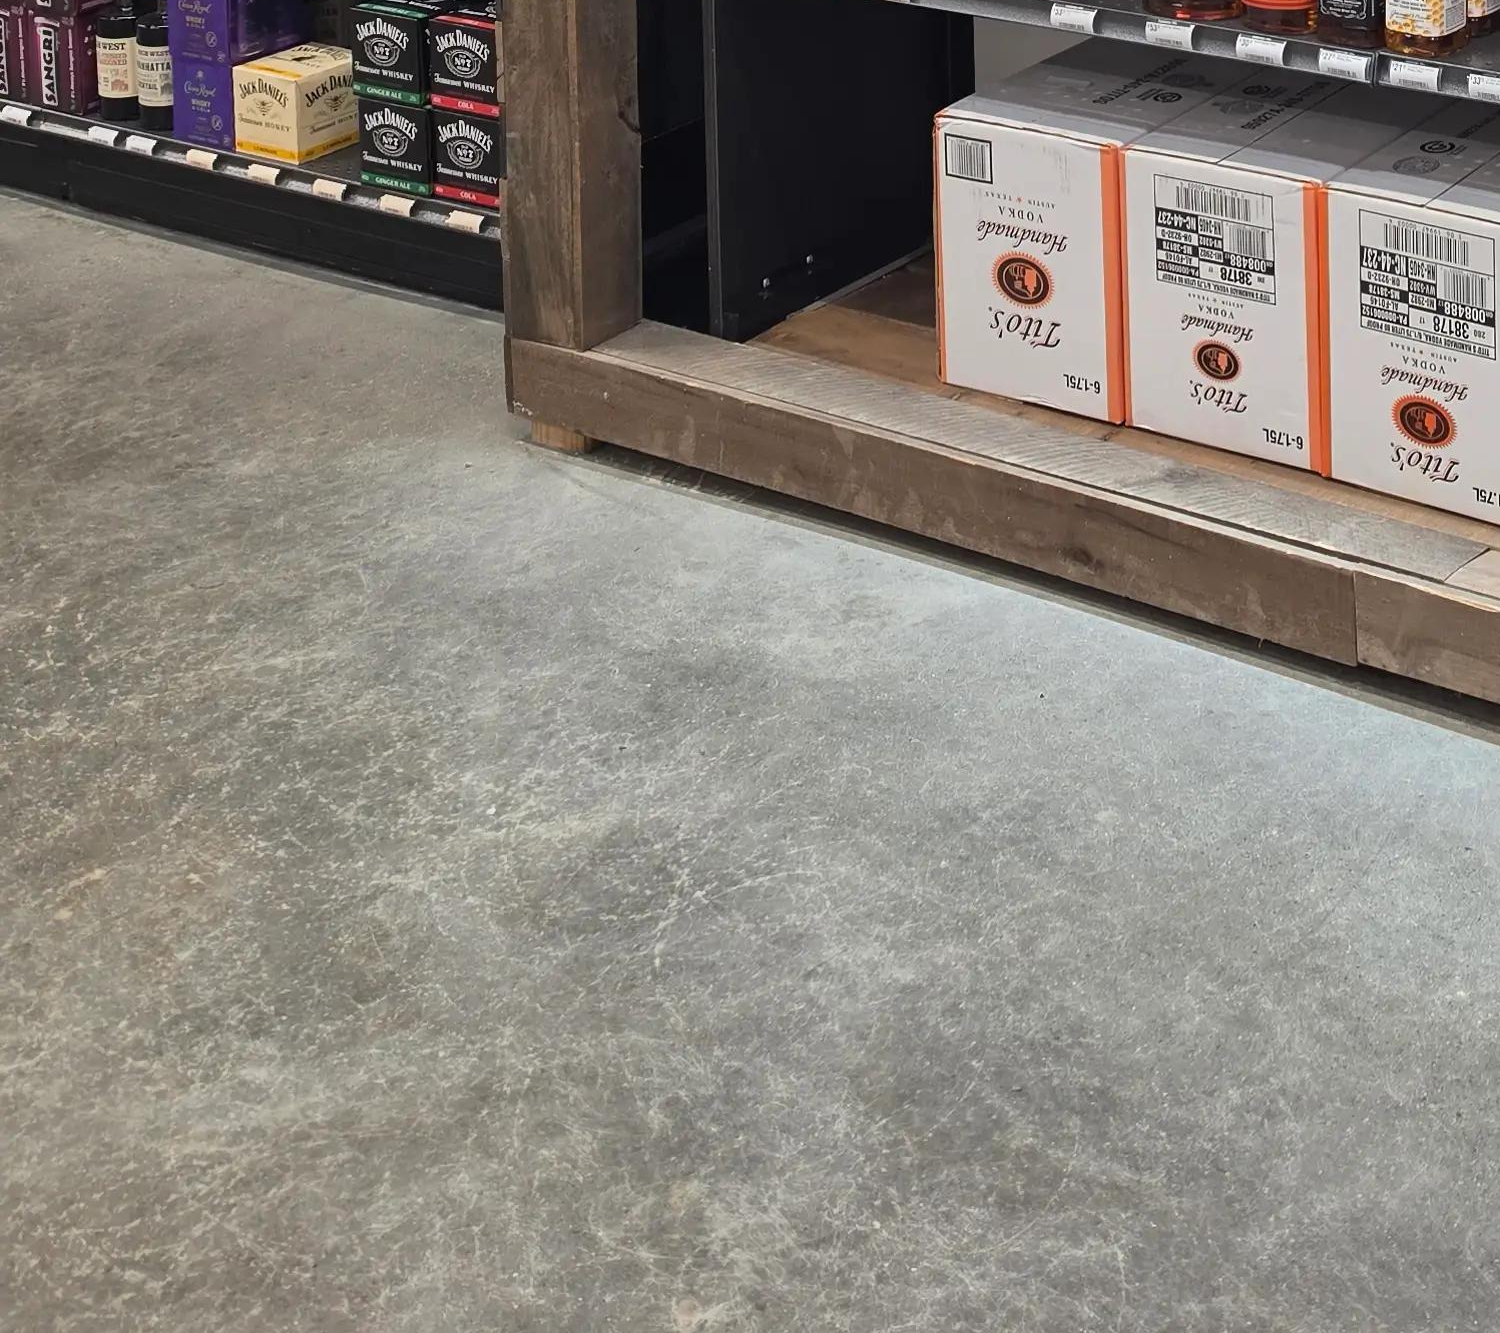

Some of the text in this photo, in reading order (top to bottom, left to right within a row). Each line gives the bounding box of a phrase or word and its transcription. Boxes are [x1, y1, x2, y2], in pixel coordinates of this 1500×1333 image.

[457, 100, 474, 111] COLA
[437, 119, 493, 154] JACK DANIEL'S
[391, 159, 422, 172] WHISKEY
[465, 171, 498, 184] WHISKEY
[459, 190, 476, 201] COLA
[1230, 256, 1267, 273] 008488
[1362, 247, 1407, 276] NC-44-237
[1220, 268, 1252, 285] 38178
[1444, 302, 1486, 324] 008488
[1433, 315, 1469, 340] 38178
